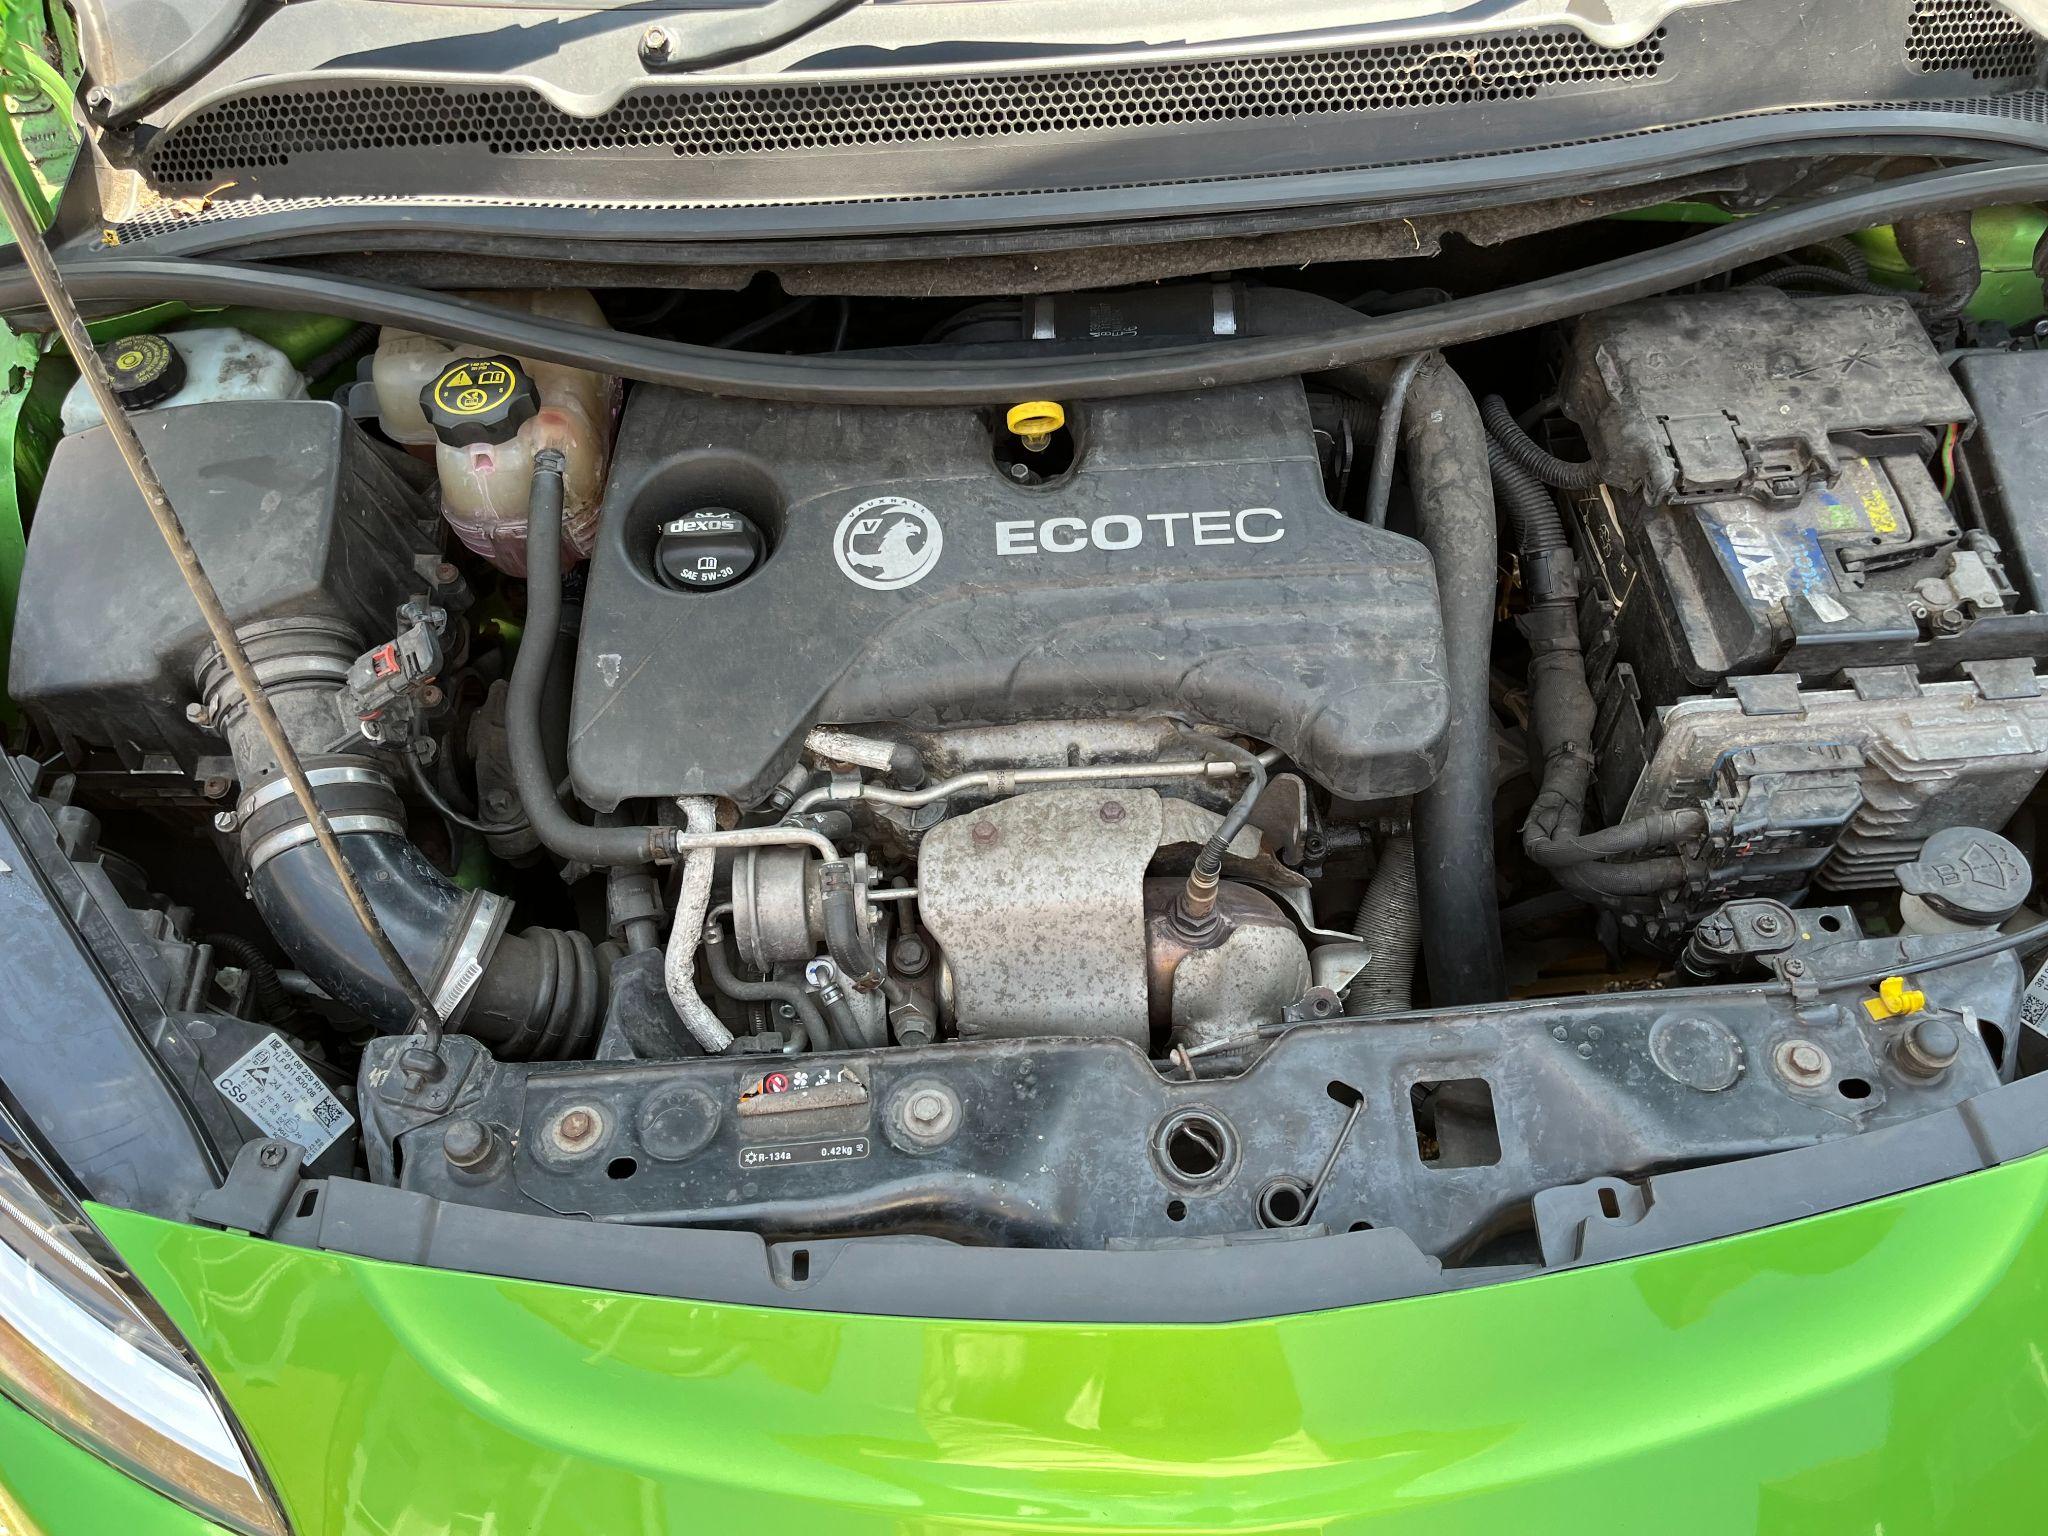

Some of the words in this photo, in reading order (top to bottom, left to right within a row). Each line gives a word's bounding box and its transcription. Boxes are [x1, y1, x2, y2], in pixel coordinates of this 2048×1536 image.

[849, 498, 926, 518] VAUXHALL
[670, 519, 735, 533] dexos
[862, 520, 878, 532] V
[995, 507, 1285, 555] ECOTEC
[680, 568, 699, 581] SAE
[701, 566, 734, 582] 5W-30
[281, 1047, 296, 1063] 391
[293, 1060, 304, 1073] 08
[301, 1068, 316, 1083] 229
[312, 1079, 326, 1093] RH
[219, 1078, 248, 1104] CS9
[281, 1089, 296, 1104] 12V
[758, 1151, 792, 1163] R-134a
